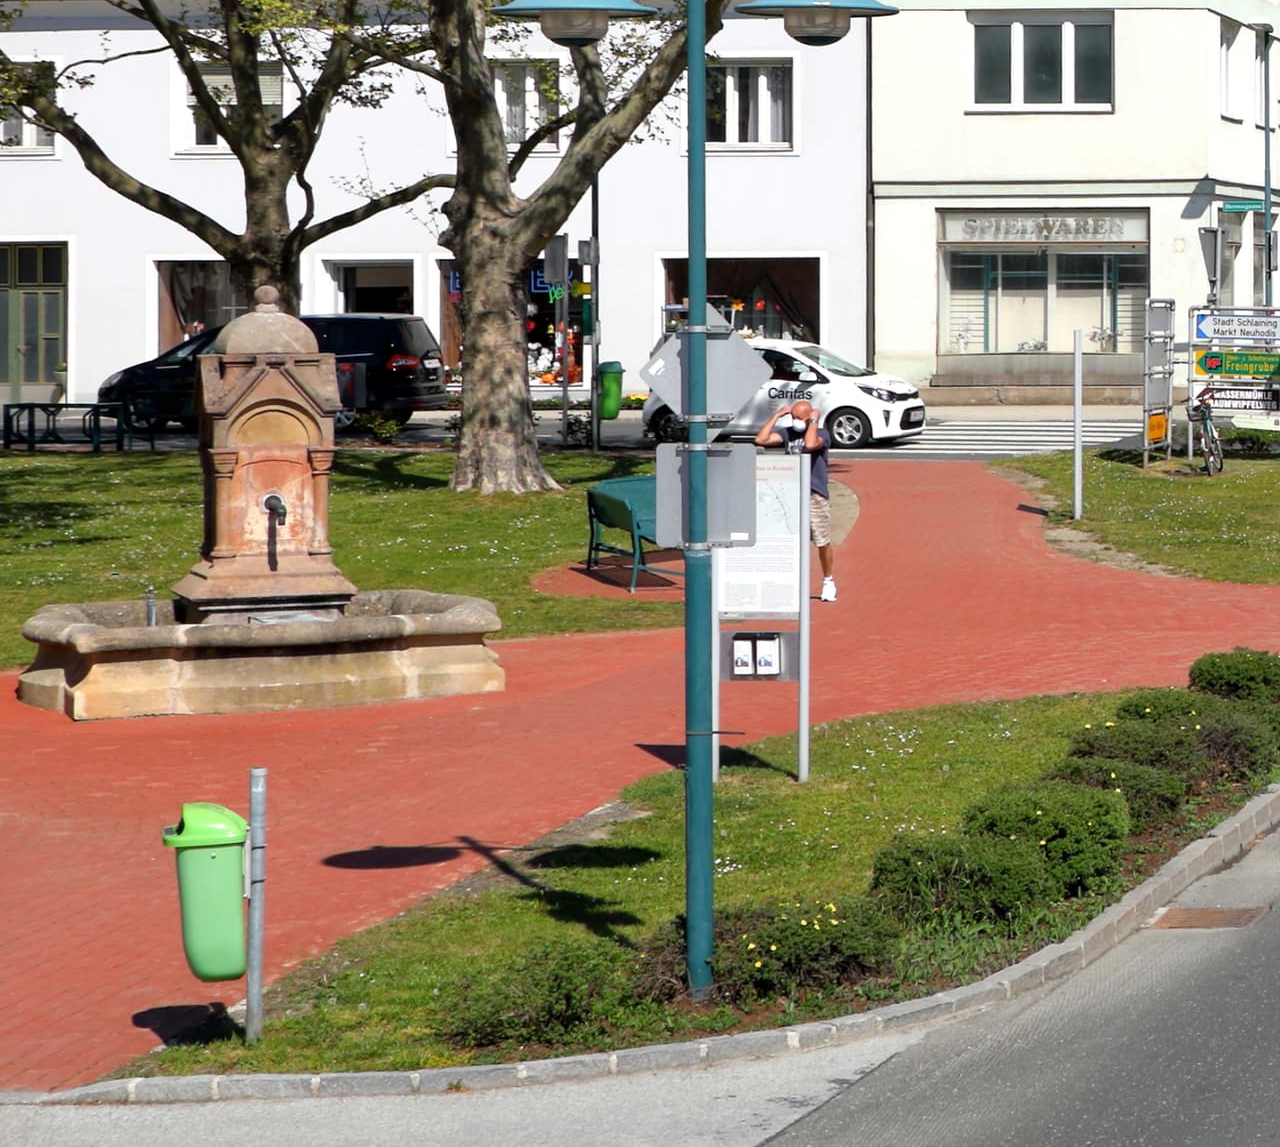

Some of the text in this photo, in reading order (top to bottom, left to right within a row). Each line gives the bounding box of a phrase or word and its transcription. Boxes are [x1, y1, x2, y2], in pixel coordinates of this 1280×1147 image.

[963, 217, 1126, 236] SPIELWAREN
[1212, 317, 1278, 329] Stadt Schlaining
[1213, 328, 1276, 338] Markt Neuhodis
[1226, 361, 1278, 373] Freingruber
[768, 387, 813, 400] Caritas
[1214, 390, 1273, 400] WASSERMÜHLE
